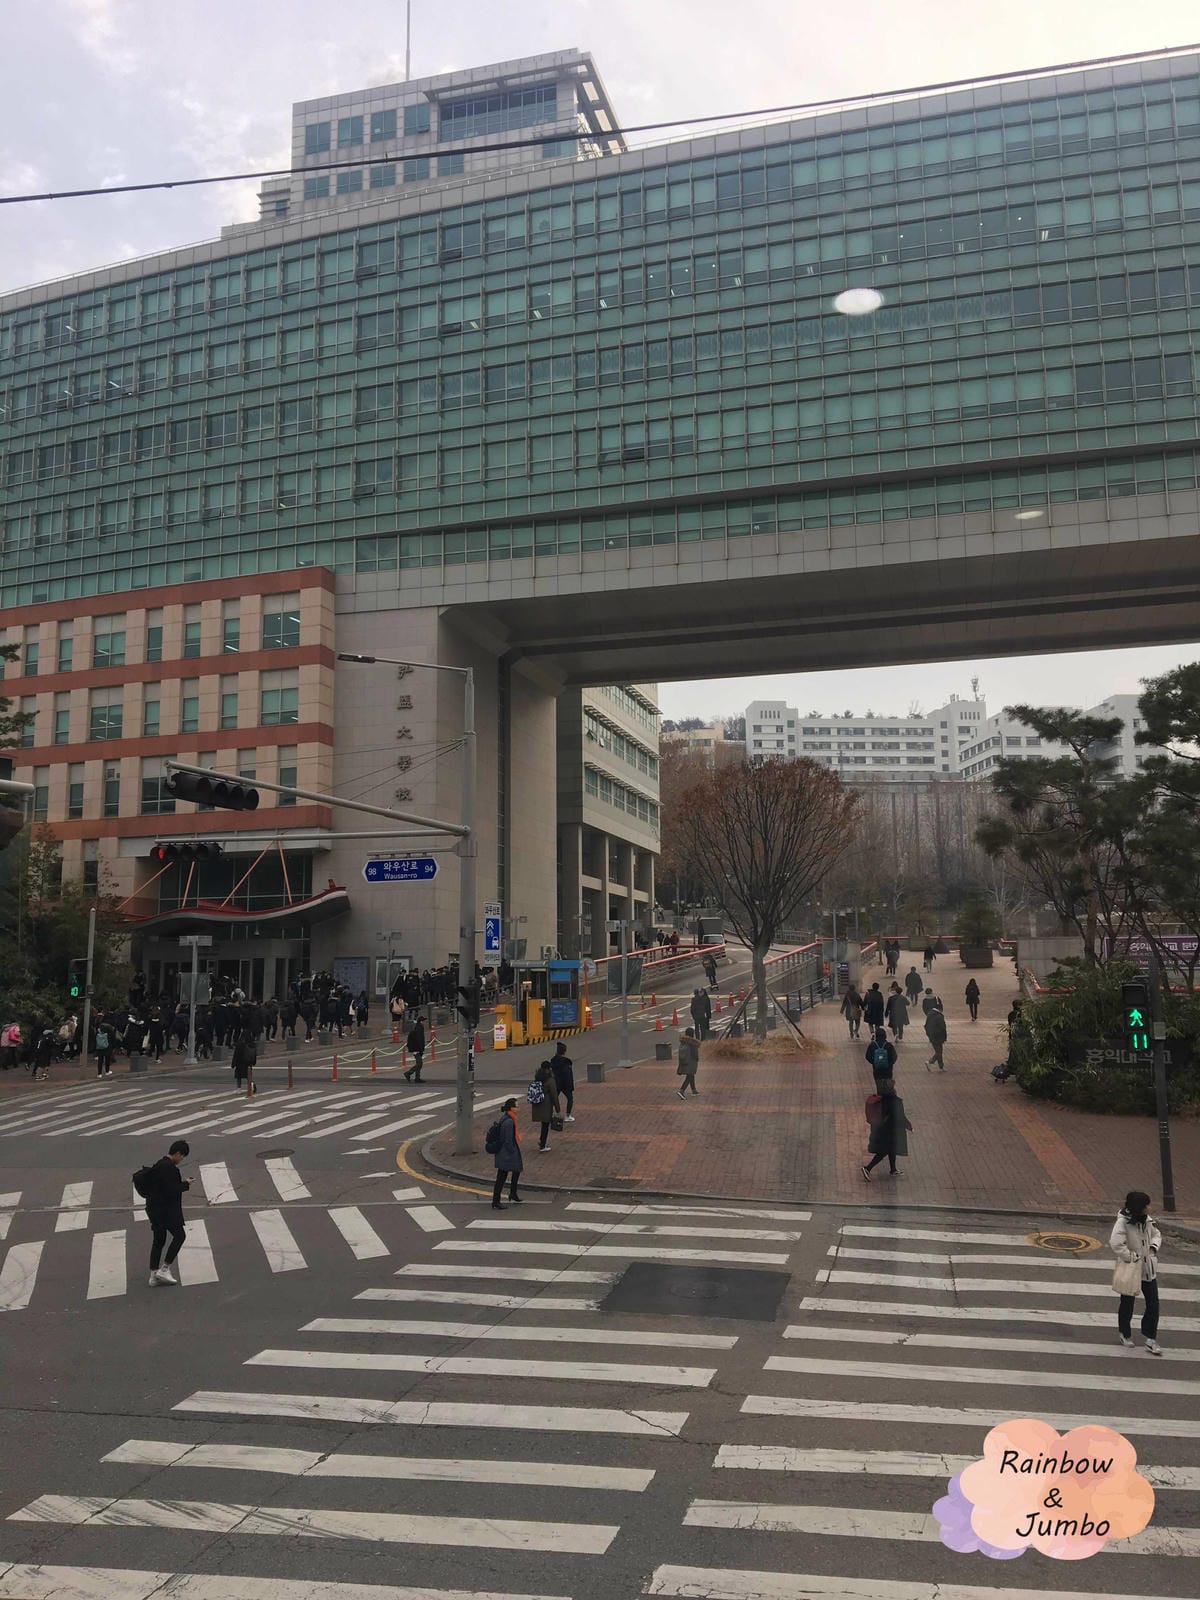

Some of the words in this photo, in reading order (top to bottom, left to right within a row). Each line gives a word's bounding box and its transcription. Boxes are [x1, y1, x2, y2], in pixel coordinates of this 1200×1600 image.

[367, 867, 377, 876] 98
[383, 861, 419, 871] 와우산로
[424, 865, 433, 873] 94
[1133, 1033, 1148, 1049] 11
